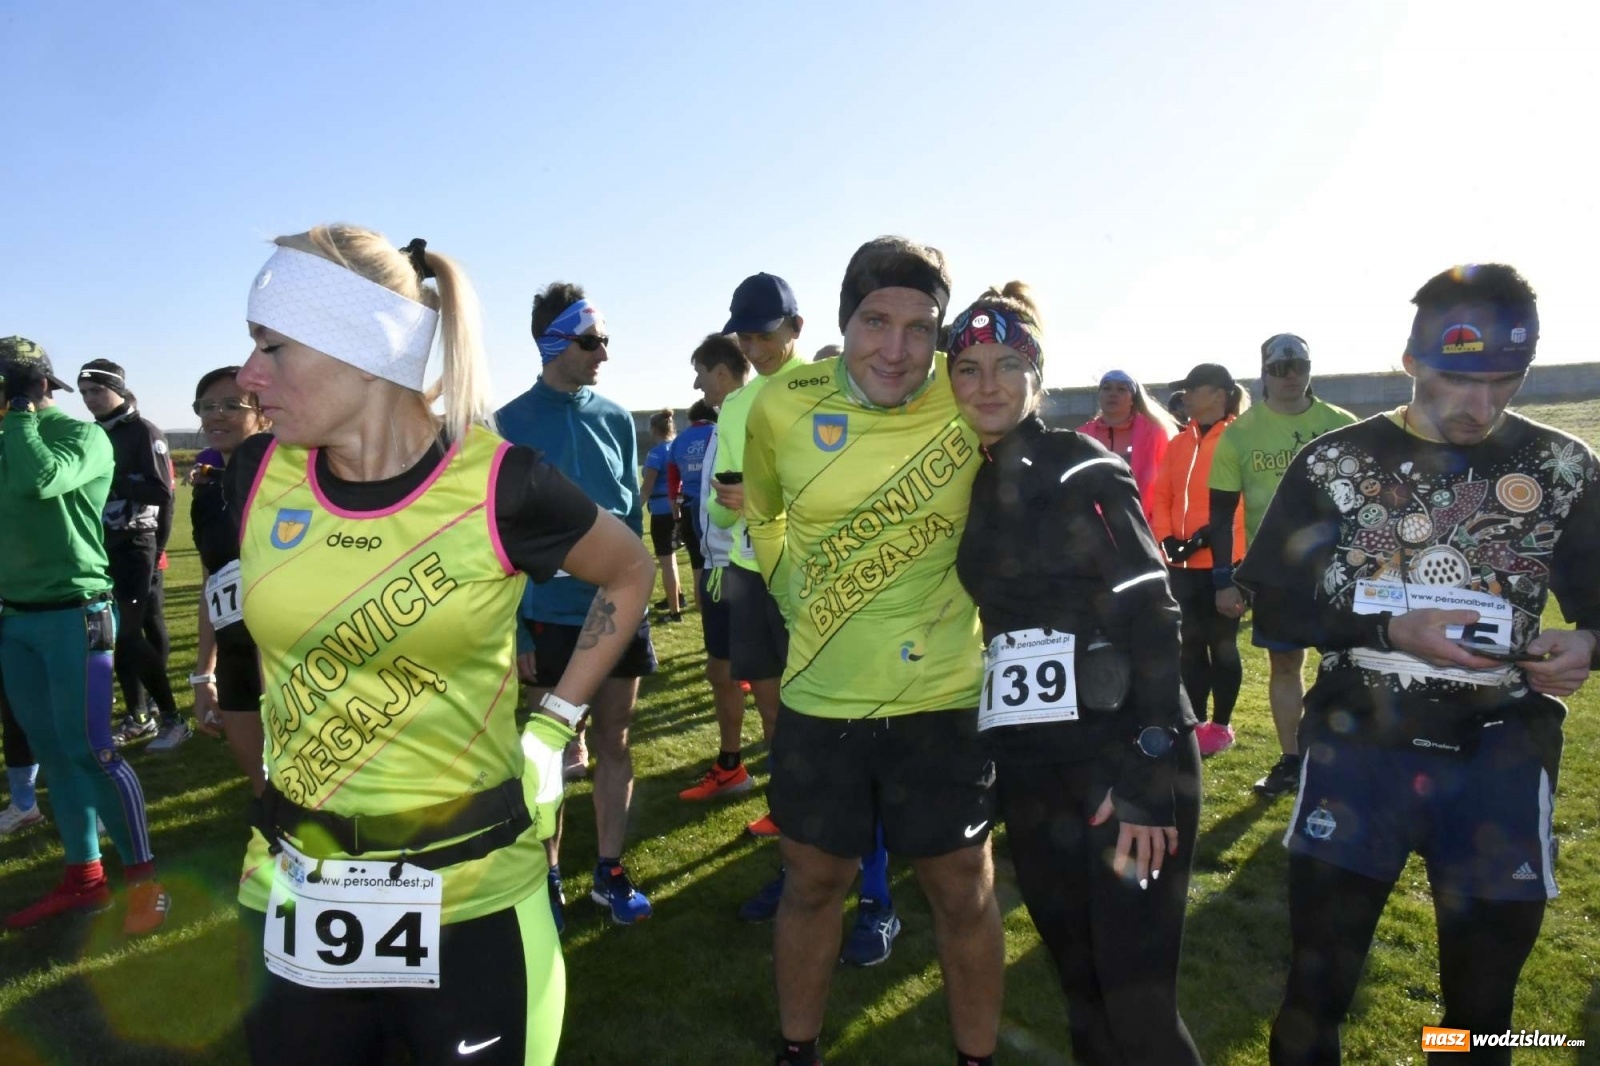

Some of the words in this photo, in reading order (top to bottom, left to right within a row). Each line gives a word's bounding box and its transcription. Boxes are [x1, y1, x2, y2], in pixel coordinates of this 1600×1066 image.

[787, 375, 830, 390] deep
[326, 531, 383, 552] deep
[809, 512, 953, 636] BIEGAJĄ
[1410, 592, 1506, 611] www.personalbest.pl
[984, 659, 1067, 711] 139
[279, 655, 448, 807] BIEGAJĄ
[275, 897, 428, 967] 194
